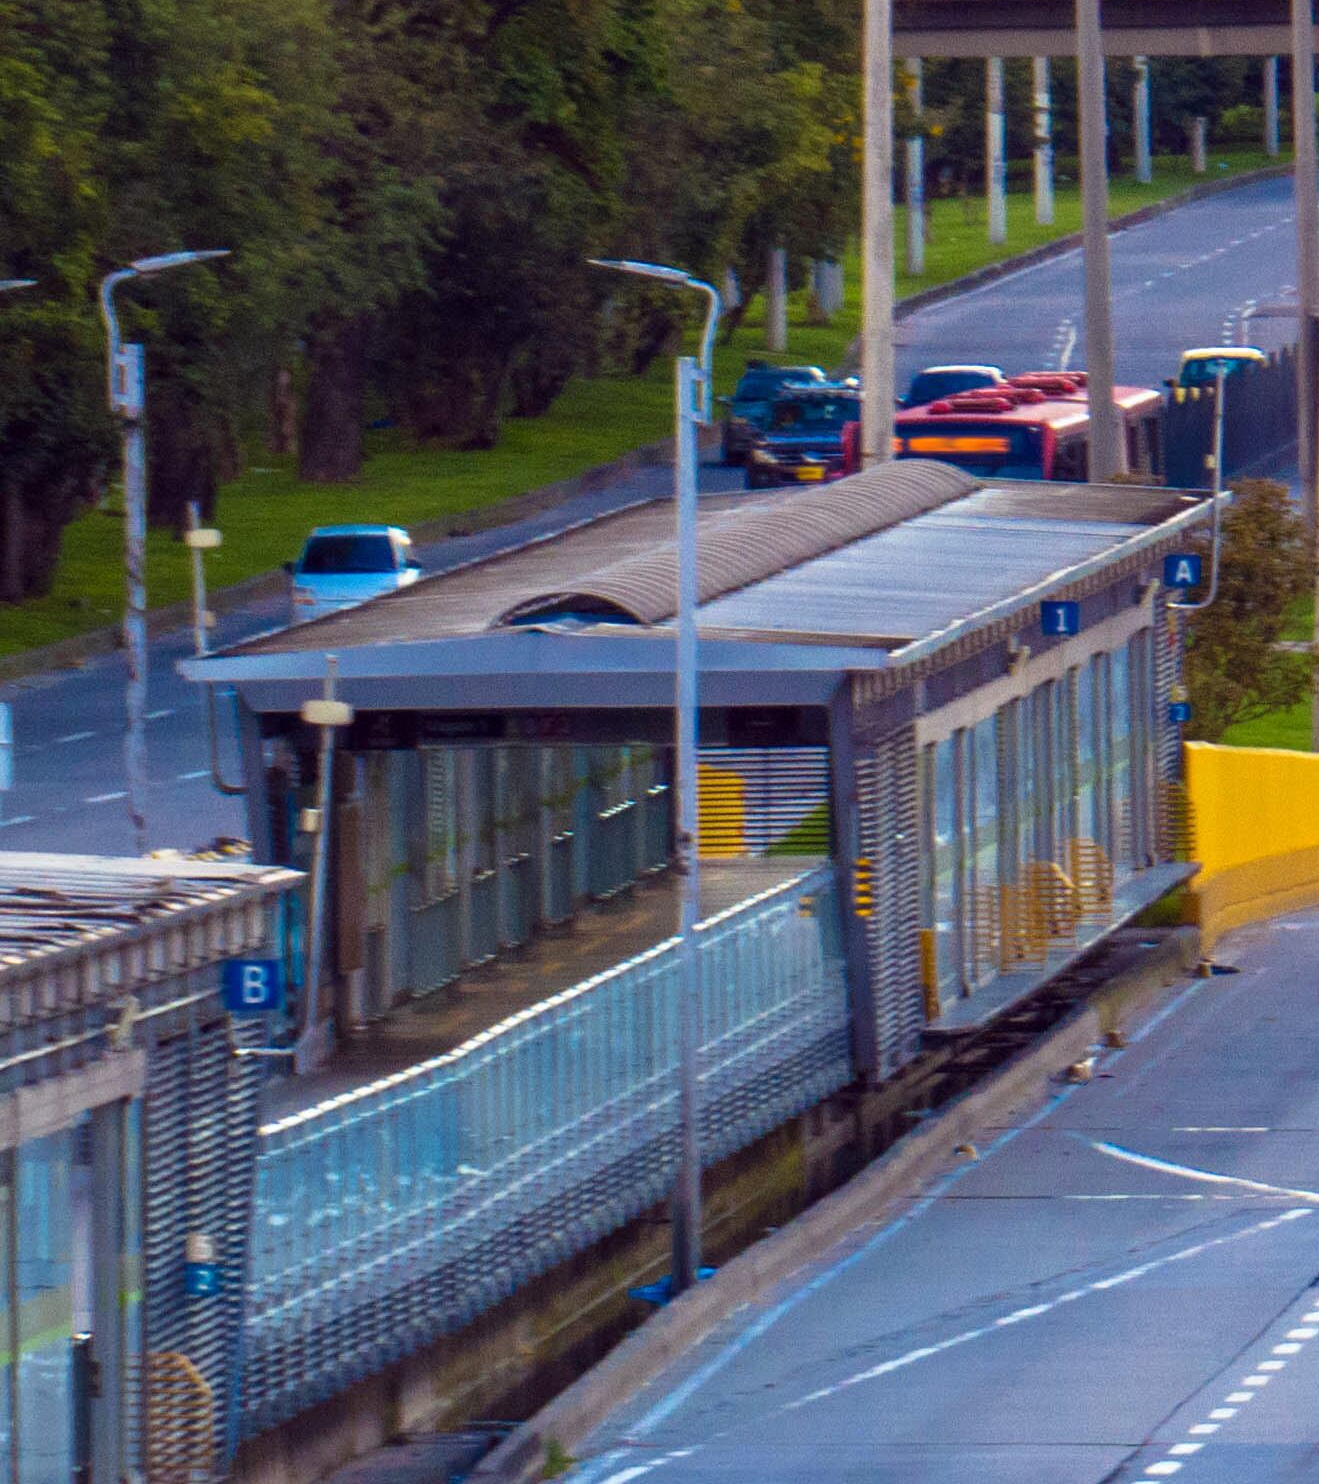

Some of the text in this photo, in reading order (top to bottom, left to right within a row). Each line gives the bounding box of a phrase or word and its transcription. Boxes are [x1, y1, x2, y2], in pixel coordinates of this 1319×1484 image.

[1175, 559, 1192, 583] A
[1056, 608, 1069, 632] 1
[243, 965, 268, 1004] B
